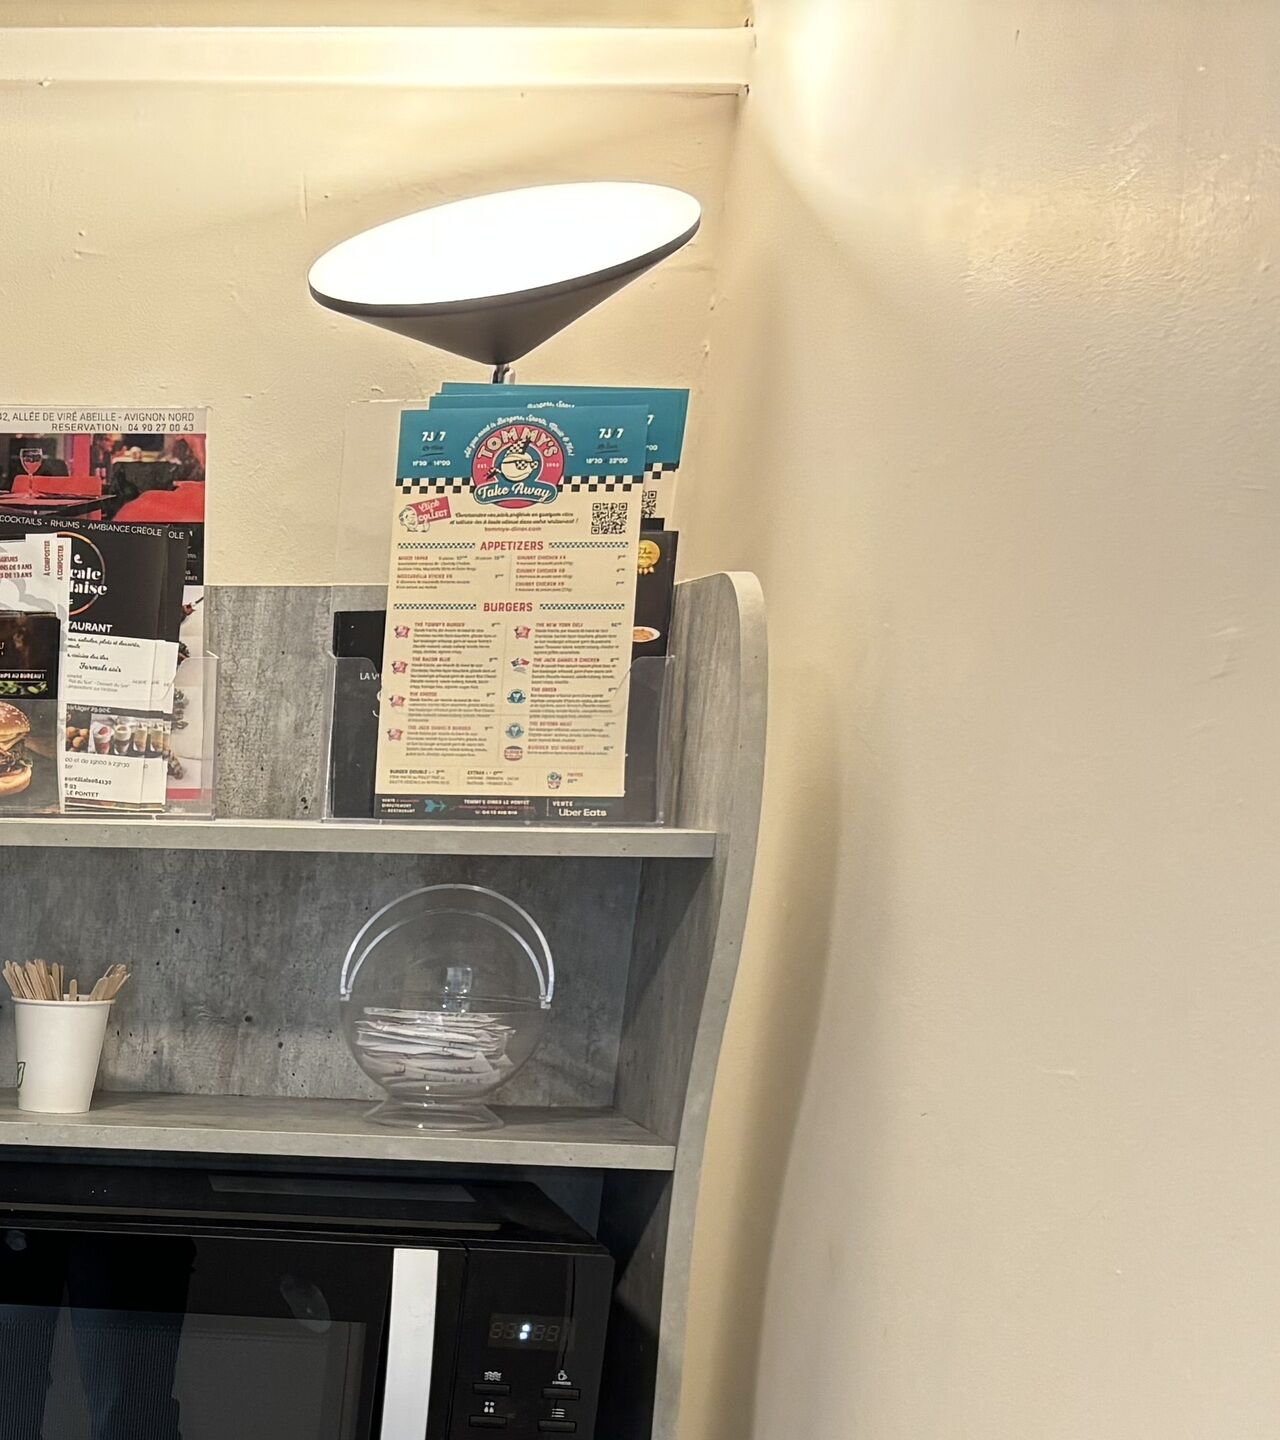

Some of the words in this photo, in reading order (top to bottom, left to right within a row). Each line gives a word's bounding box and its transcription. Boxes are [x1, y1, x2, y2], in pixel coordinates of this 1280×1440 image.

[12, 410, 41, 422] ALLÉE
[42, 412, 55, 422] DE
[58, 410, 78, 422] VIRÉ
[80, 412, 117, 422] ABEILLE
[124, 412, 166, 422] AVIGNON
[168, 412, 195, 422] NORD
[52, 422, 122, 432] RESERVATION:
[128, 423, 140, 432] 04
[142, 423, 155, 432] 90
[156, 423, 168, 432] 27
[170, 423, 182, 432] 00
[182, 423, 195, 432] 43
[477, 426, 560, 459] TOMMY'S
[478, 484, 510, 500] Take
[511, 484, 552, 502] Away
[419, 510, 449, 523] COLLECT
[50, 520, 80, 530] RHUMS
[88, 522, 130, 533] AMBIANCE
[480, 540, 544, 551] APPETIZERS
[482, 602, 534, 612] BURGERS
[558, 808, 582, 818] Uber
[582, 808, 607, 818] Eats
